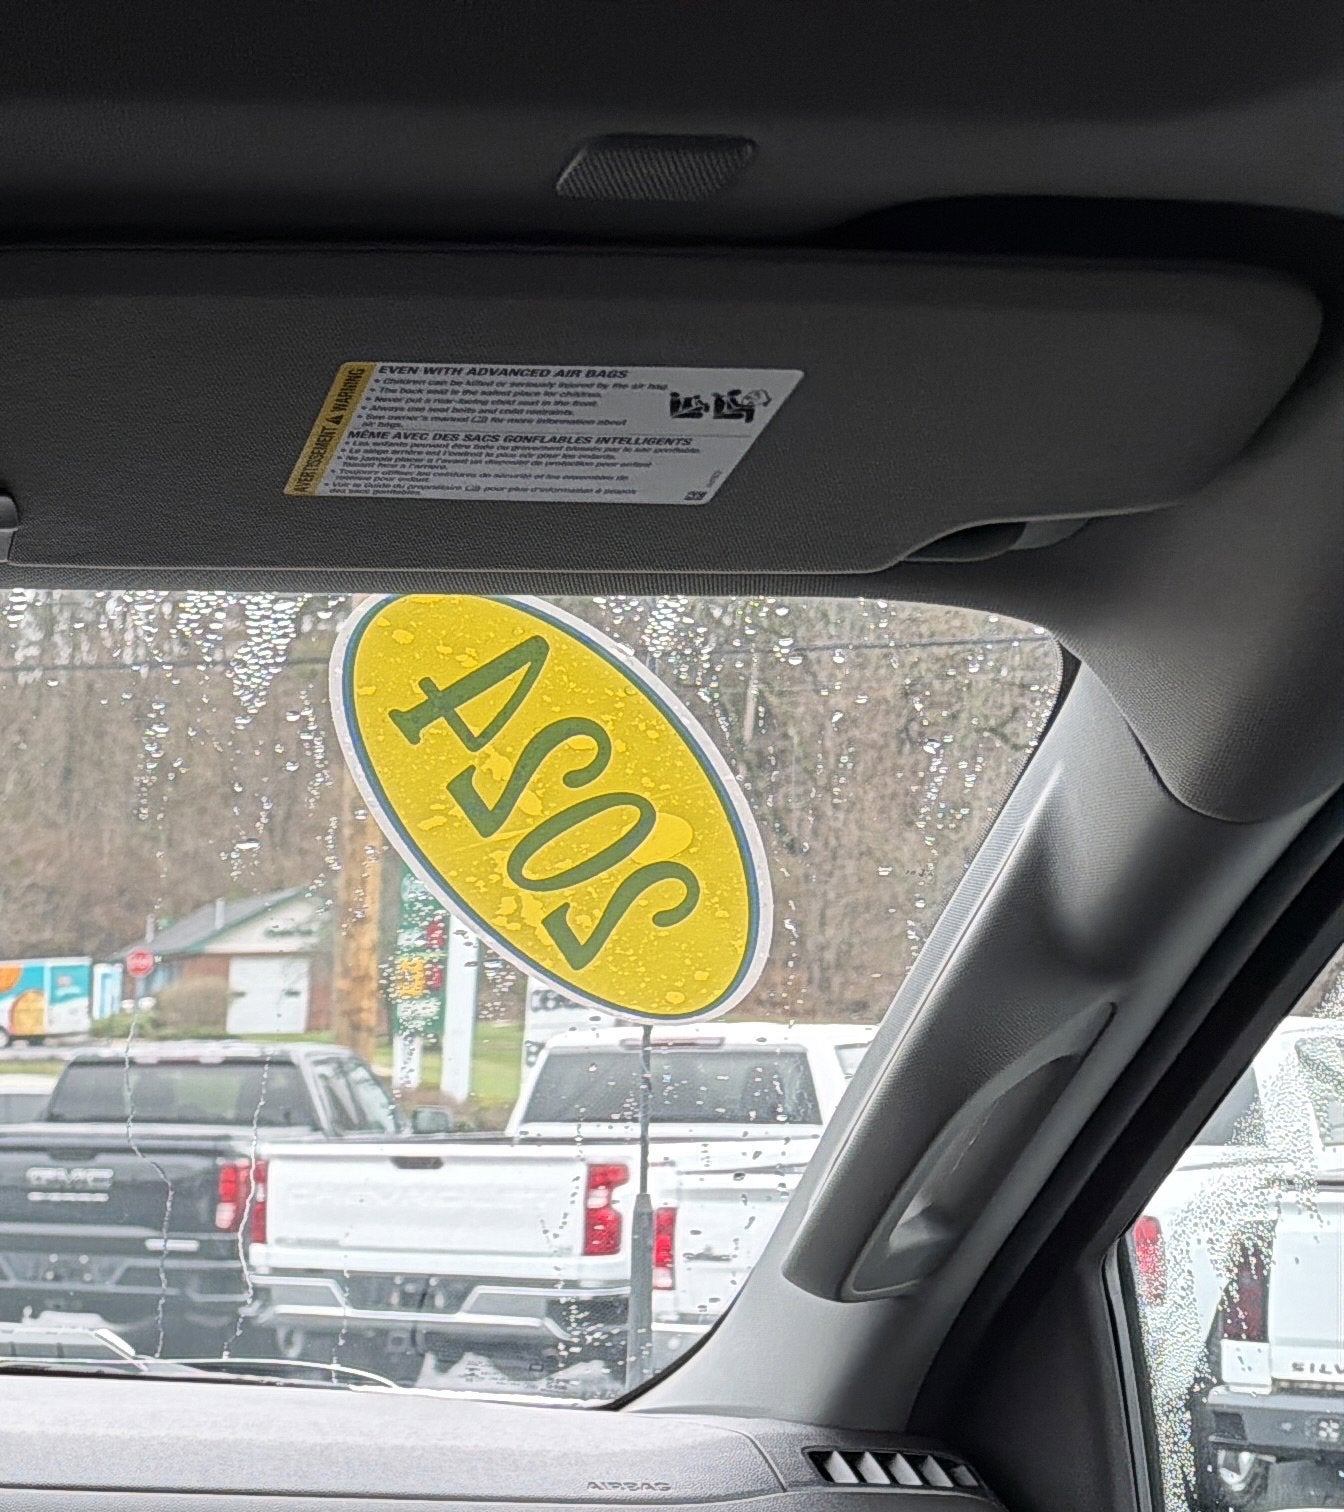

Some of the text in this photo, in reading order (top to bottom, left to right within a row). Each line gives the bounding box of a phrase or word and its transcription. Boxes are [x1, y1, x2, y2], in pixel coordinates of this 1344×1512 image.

[377, 365, 629, 378] EVEN WITH ADVANCED AIR BAGS
[330, 367, 366, 413] WARNING
[347, 428, 693, 446] MÊME AVEC DES SACS GONFLABLES INTELLIGENTS
[293, 426, 338, 493] AVERTISSEMENT
[586, 1481, 673, 1492] AIRBAG
